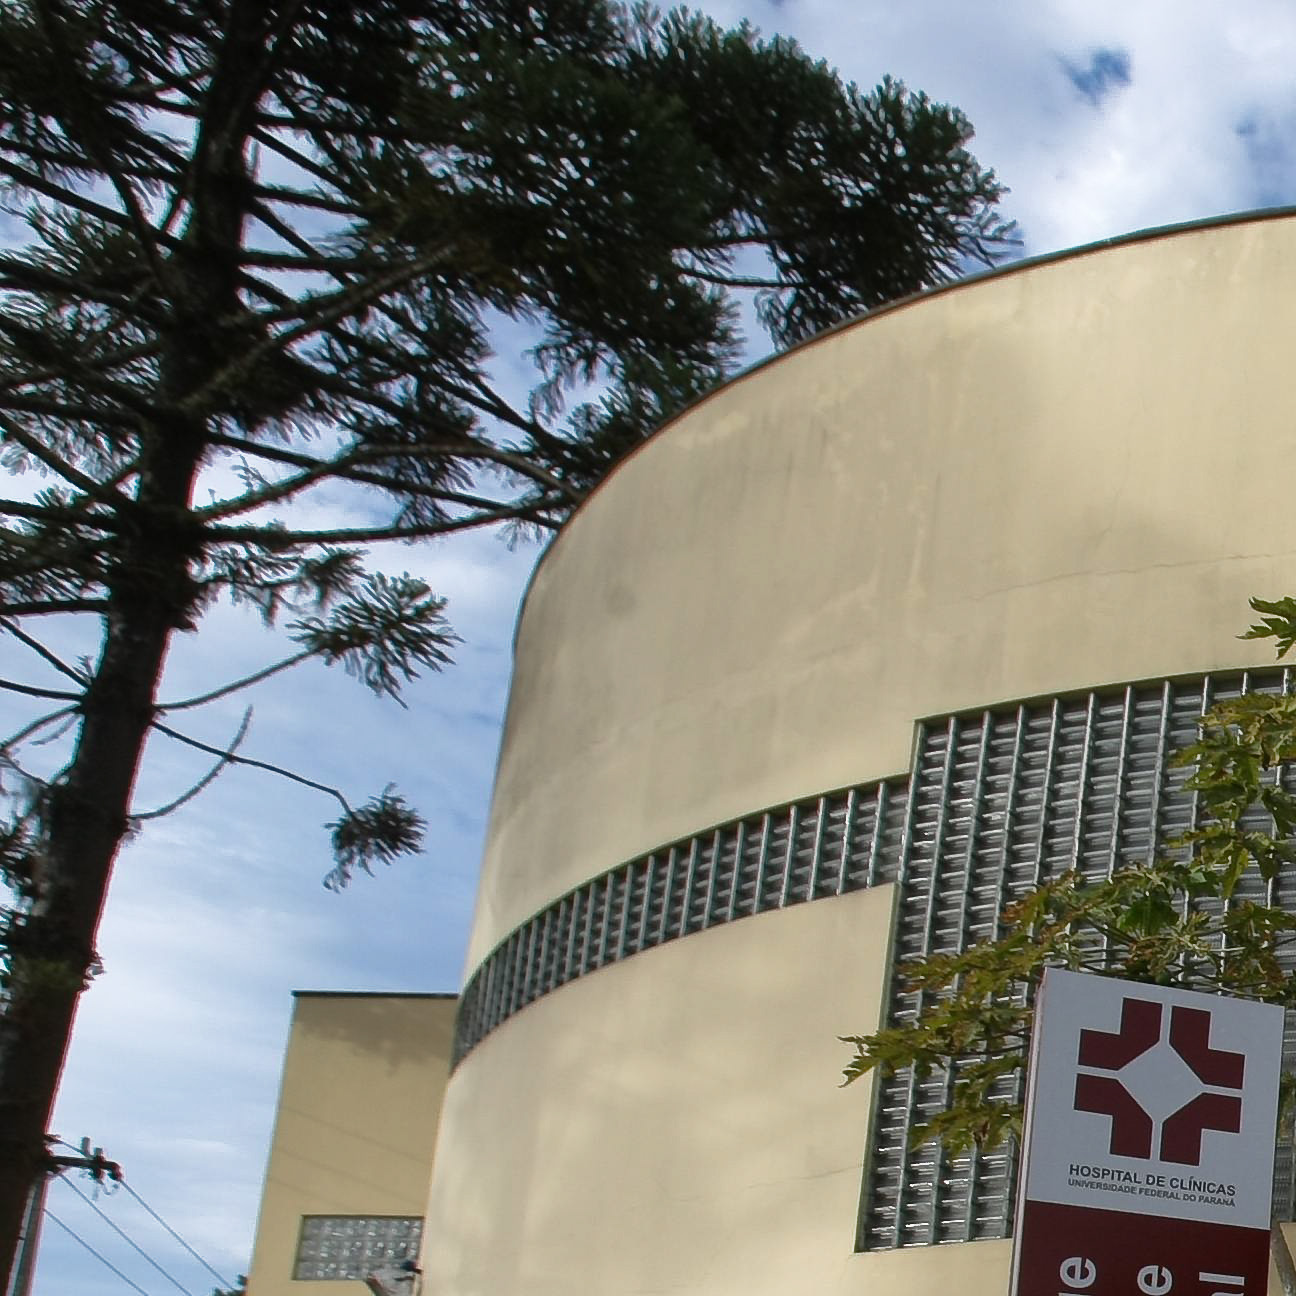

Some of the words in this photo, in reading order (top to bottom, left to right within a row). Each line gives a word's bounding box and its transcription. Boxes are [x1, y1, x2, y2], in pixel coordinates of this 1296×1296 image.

[1068, 1178, 1138, 1195] UNIVERSIDADE
[1138, 1187, 1181, 1201] FEDERAL
[1183, 1193, 1197, 1203] DO
[1069, 1164, 1142, 1185] HOSPITAL
[1146, 1174, 1166, 1188] DE
[1170, 1176, 1236, 1197] CLÍNICAS
